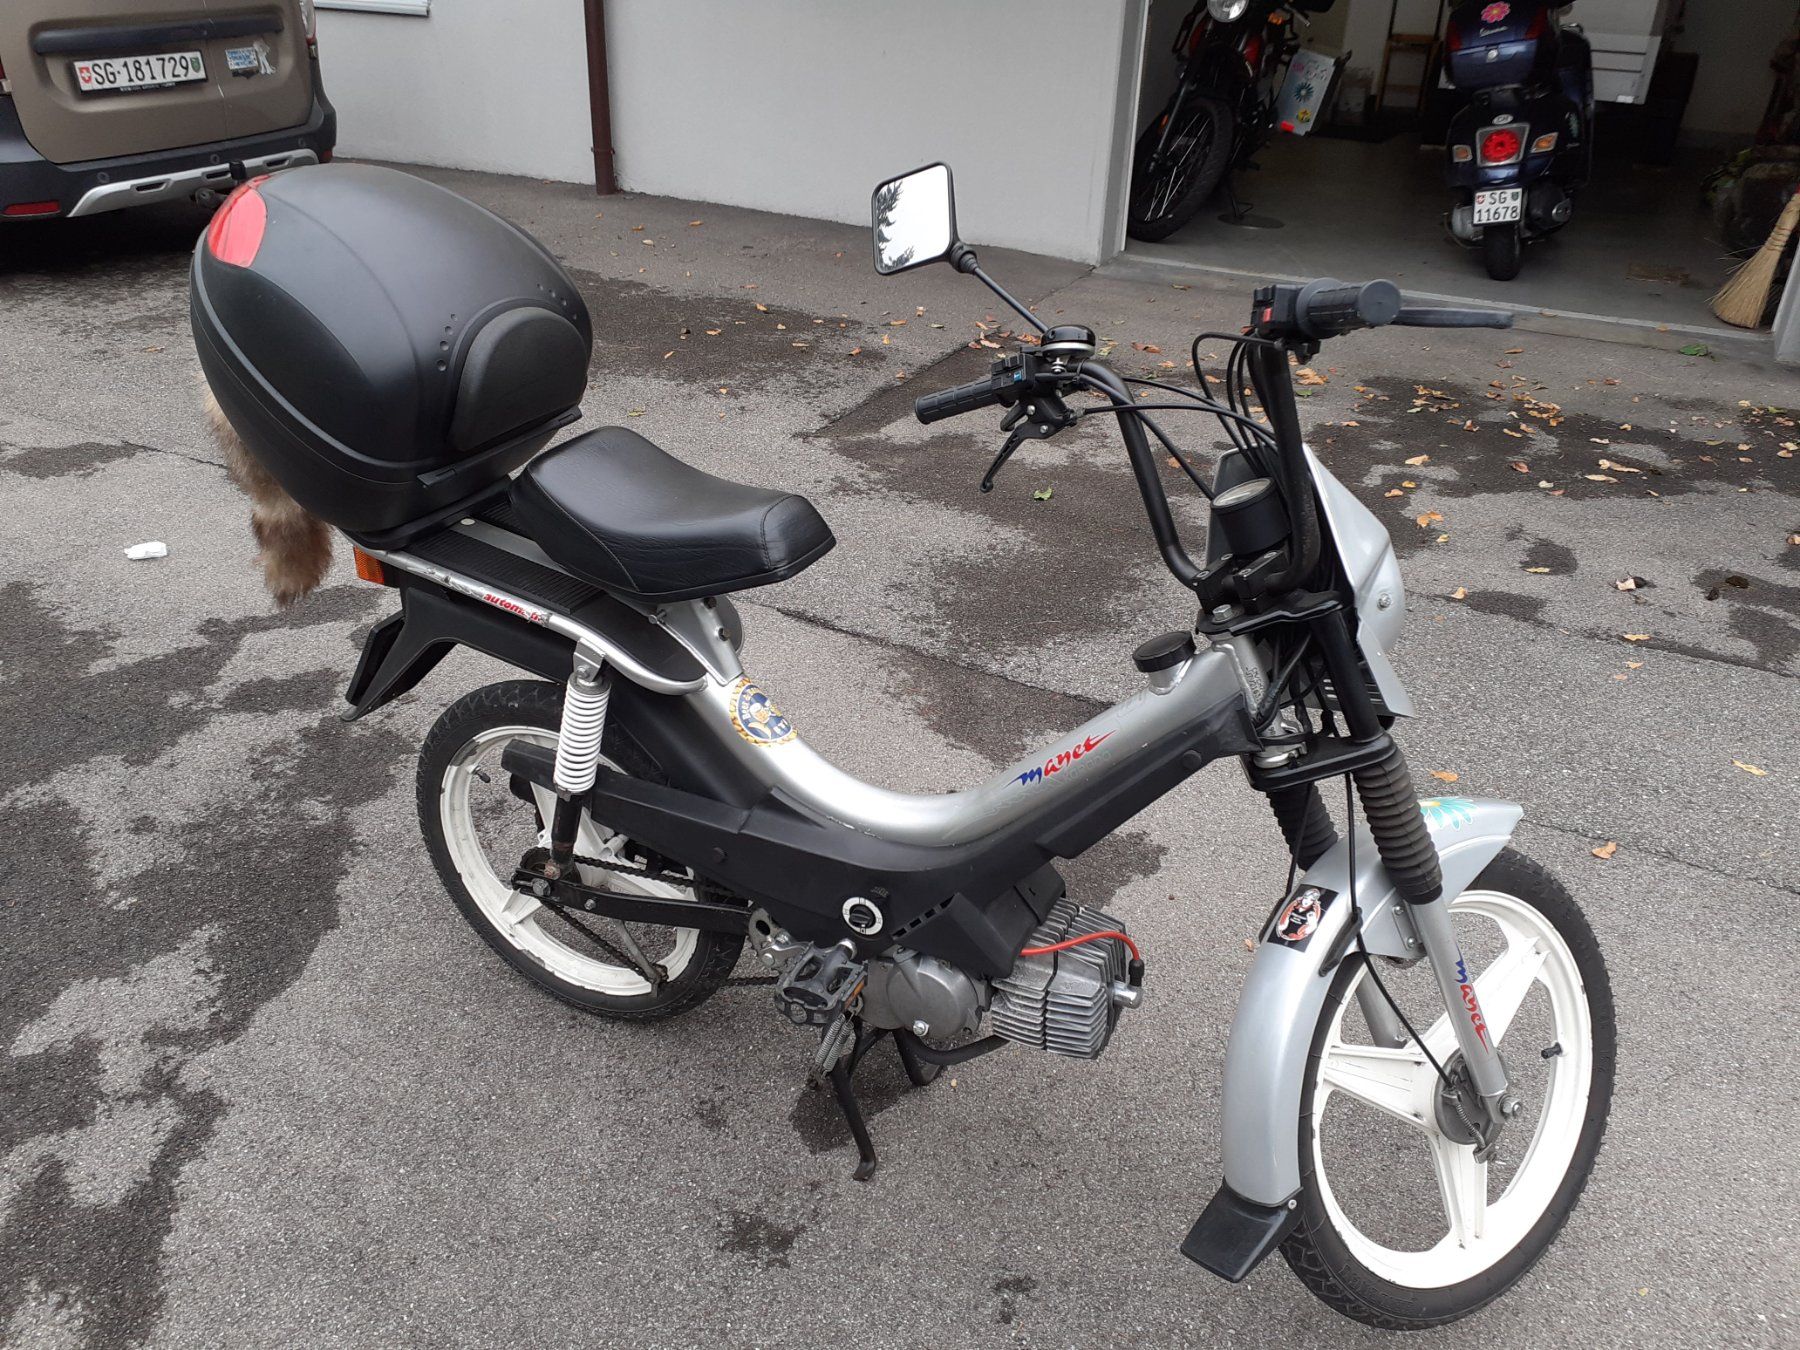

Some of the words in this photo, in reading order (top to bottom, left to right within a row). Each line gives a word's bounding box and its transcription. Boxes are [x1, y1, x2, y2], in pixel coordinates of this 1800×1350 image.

[1476, 206, 1519, 223] 11678
[1489, 191, 1507, 205] SG
[1002, 729, 1118, 790] manet
[1454, 940, 1490, 1055] manet
